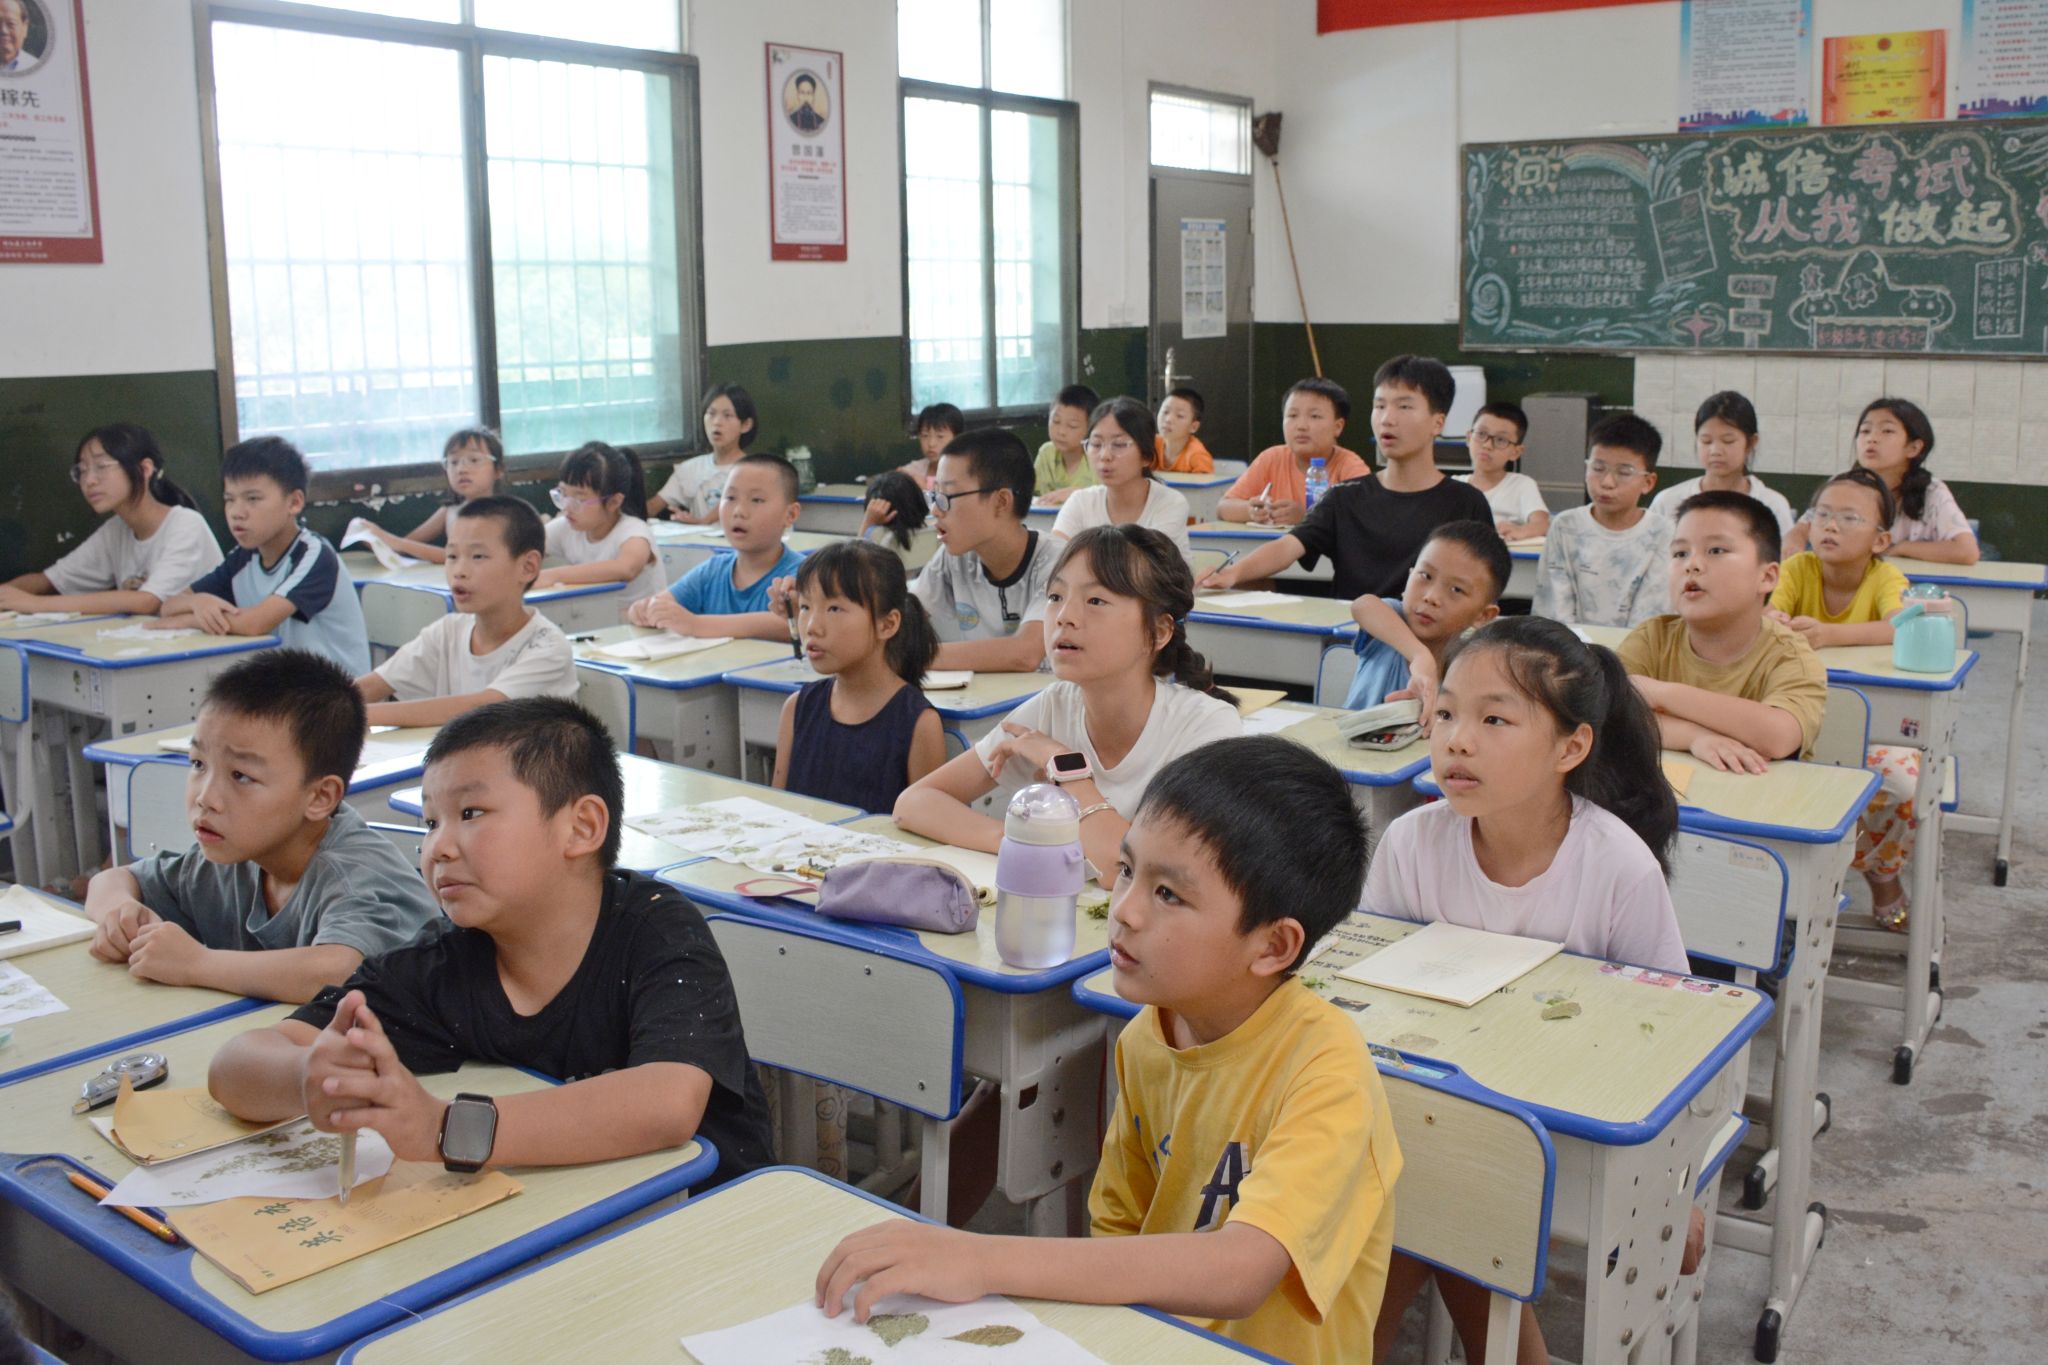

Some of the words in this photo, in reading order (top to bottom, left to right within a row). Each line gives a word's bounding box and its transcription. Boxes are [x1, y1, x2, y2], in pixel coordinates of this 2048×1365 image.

[1721, 139, 1975, 200] 诚信考试
[1744, 191, 2011, 244] 从我做起
[253, 1200, 345, 1248] 英语本
